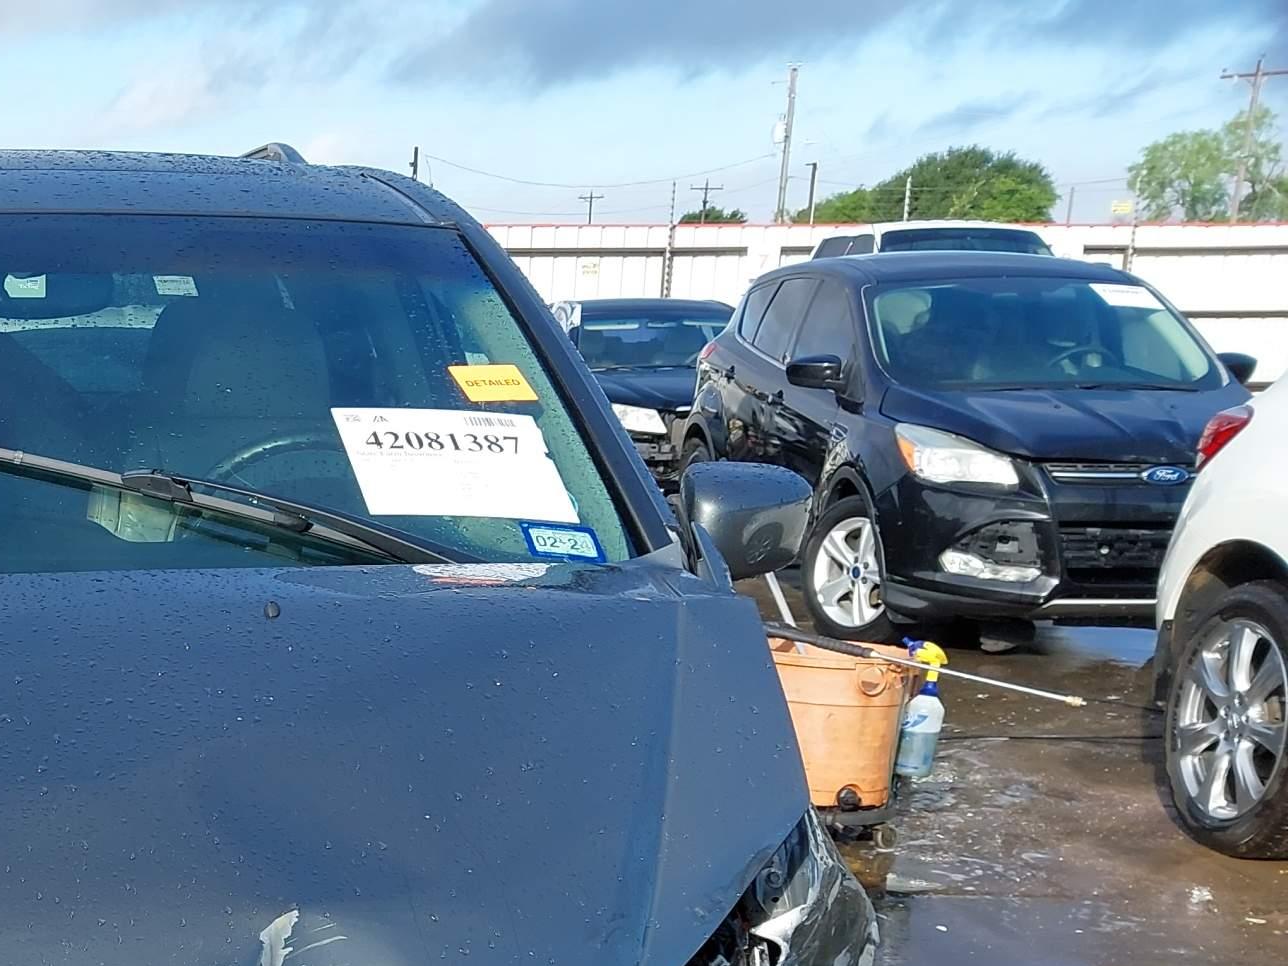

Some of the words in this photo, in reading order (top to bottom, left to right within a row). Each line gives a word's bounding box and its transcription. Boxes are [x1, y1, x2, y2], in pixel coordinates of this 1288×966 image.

[465, 379, 520, 387] DETAILED
[365, 430, 519, 455] 42081387
[1153, 469, 1180, 480] Ford
